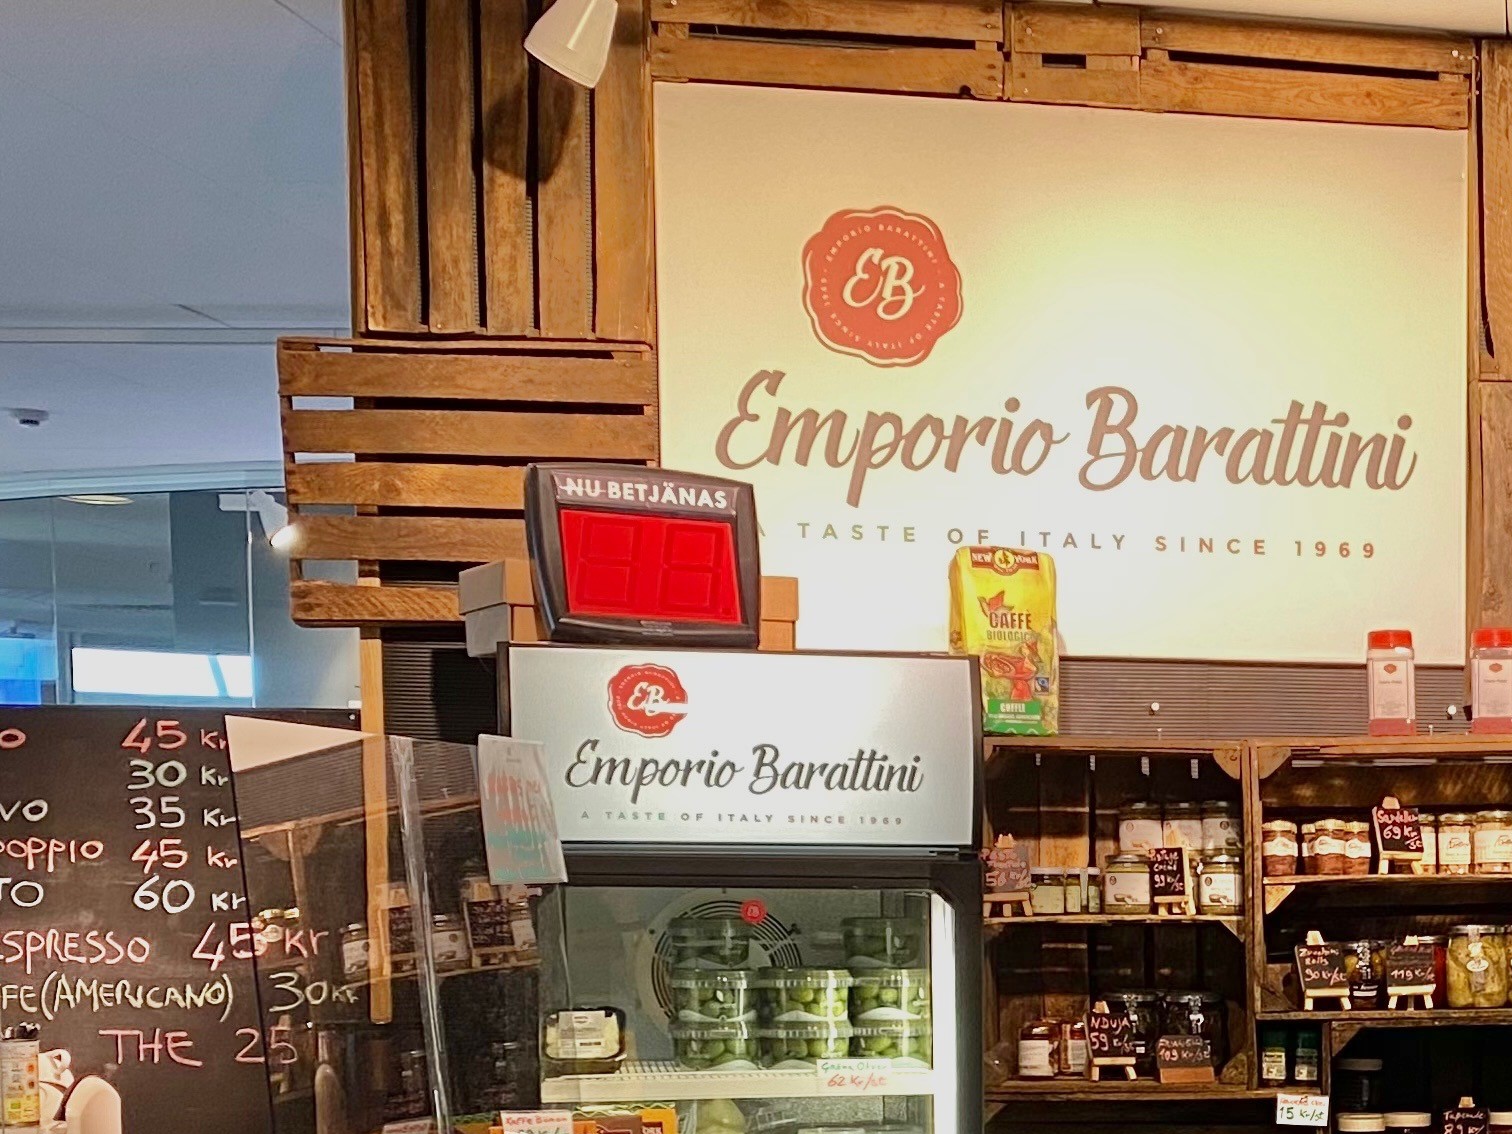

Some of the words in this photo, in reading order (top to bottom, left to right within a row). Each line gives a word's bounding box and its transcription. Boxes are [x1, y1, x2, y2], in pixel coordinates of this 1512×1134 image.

[842, 247, 926, 321] EB
[715, 370, 1070, 509] Emporio
[1079, 385, 1418, 492] Barattini
[607, 480, 727, 509] BETJÄNAS
[797, 523, 918, 544] TASTE
[947, 528, 989, 545] OF
[1020, 530, 1127, 551] ITALY
[1155, 535, 1267, 556] SINCE
[1294, 540, 1375, 559] 1969
[121, 717, 187, 753] 45
[127, 759, 187, 790] 30
[564, 738, 744, 805] Emporio
[748, 742, 923, 796] Barattini
[129, 796, 187, 830] 35
[581, 810, 590, 819] A
[606, 811, 666, 821] TASTE
[681, 812, 704, 821] OF
[718, 812, 774, 824] ITALY
[788, 814, 846, 825] SINCE
[131, 838, 188, 874] 45
[133, 875, 196, 914] 60
[192, 923, 268, 972] 45
[1090, 1032, 1108, 1050] 59
[1091, 1017, 1130, 1034] NDUJA
[99, 1028, 203, 1067] THE
[235, 1026, 298, 1064] 25
[828, 1074, 846, 1087] 62
[1280, 1107, 1294, 1119] 15
